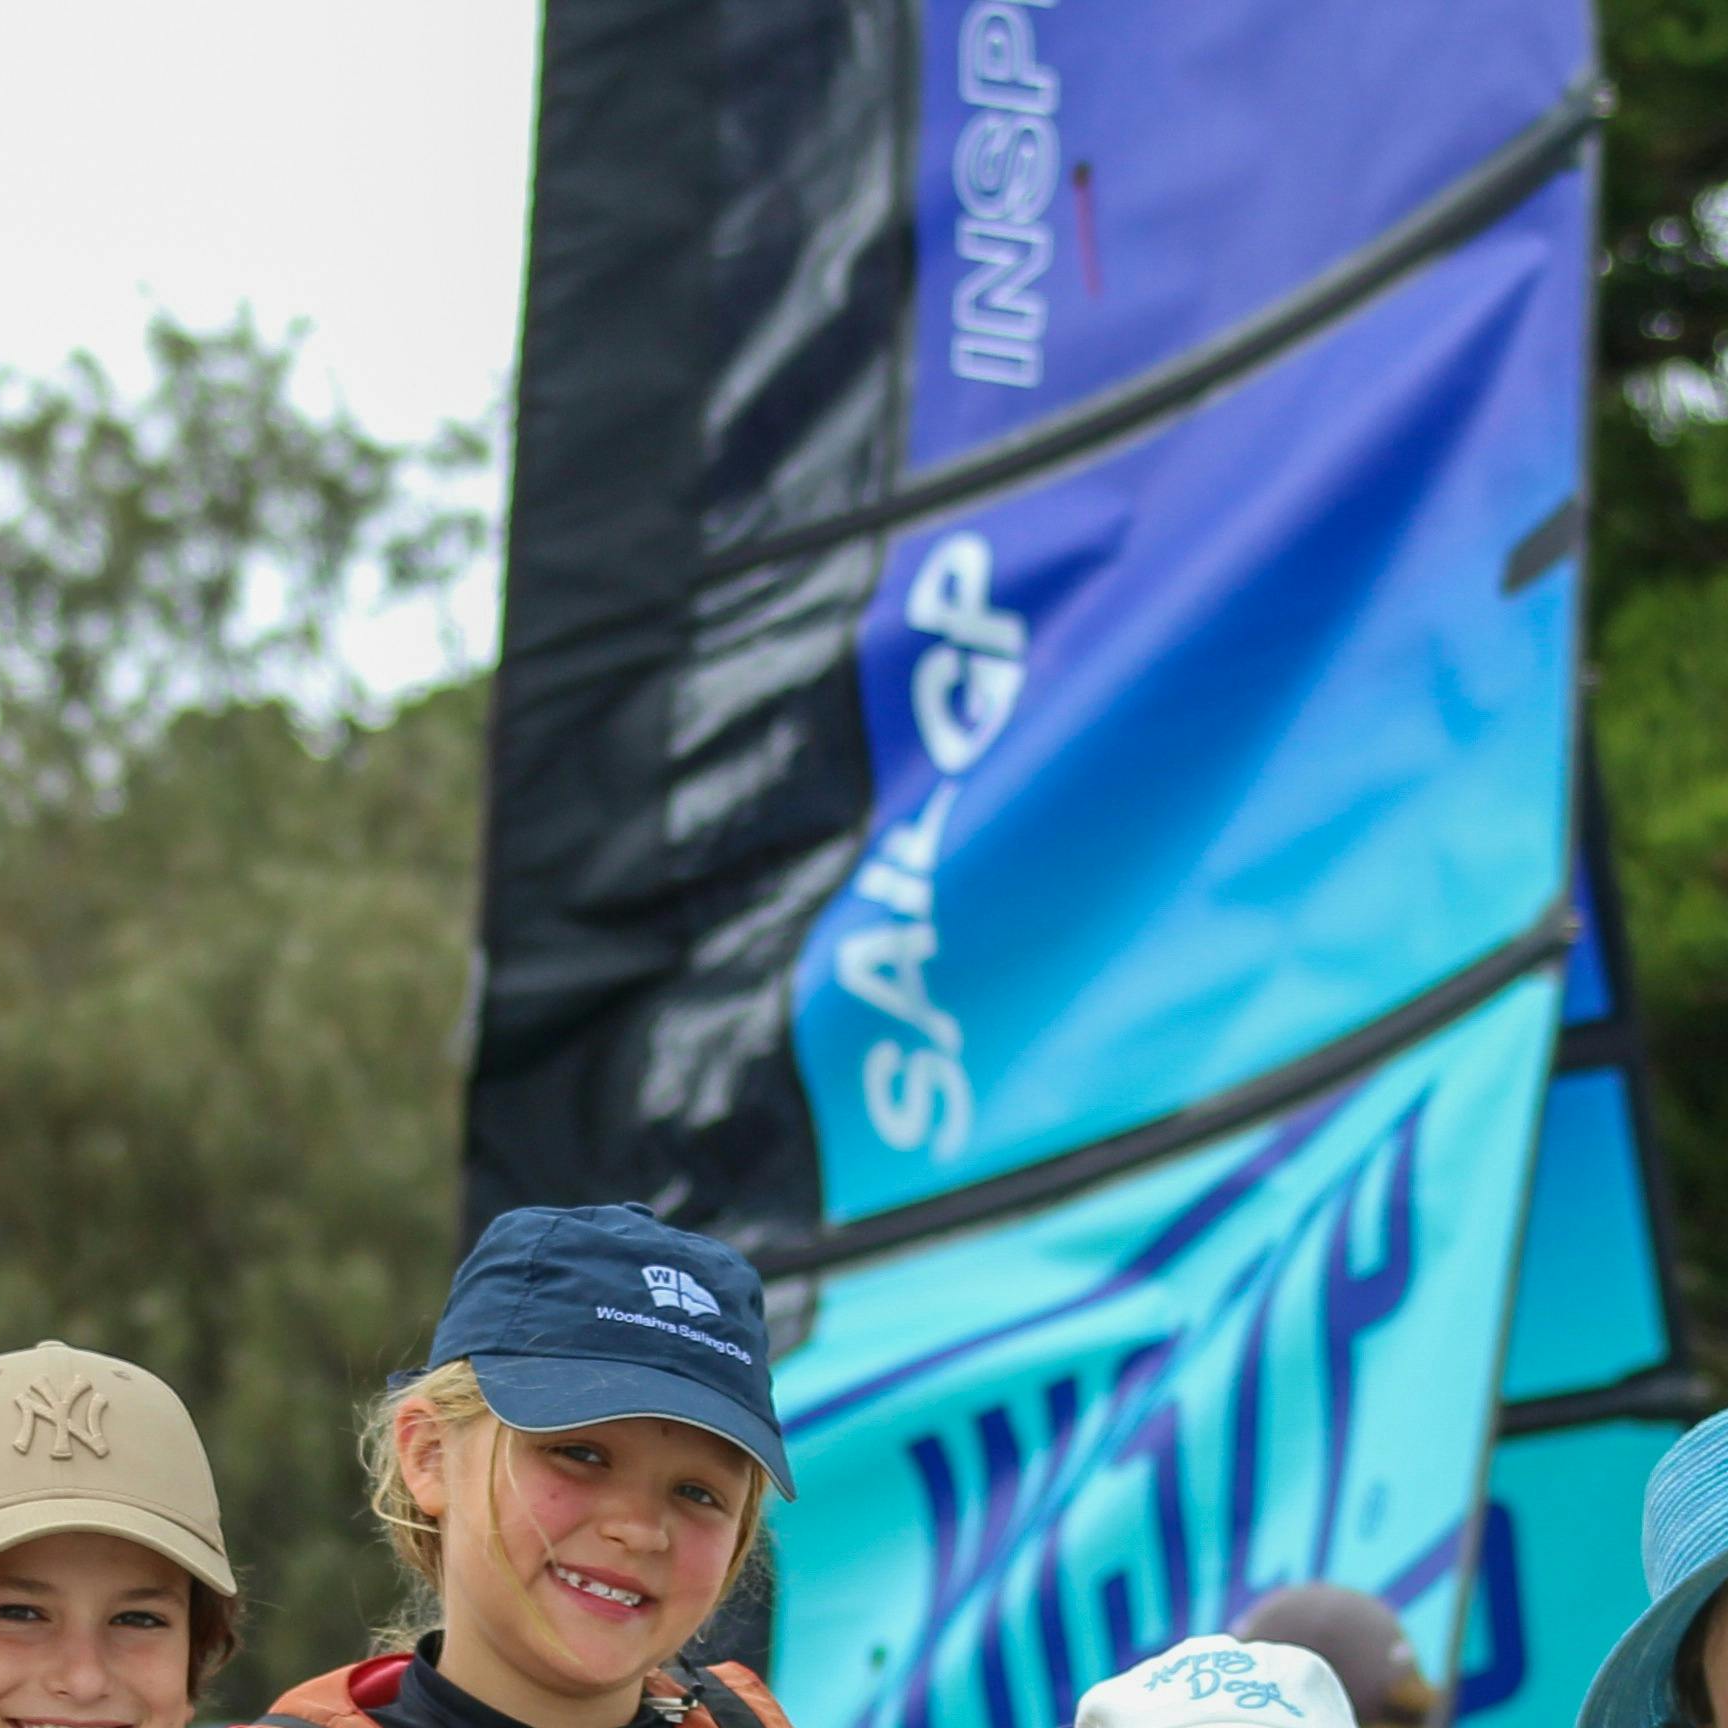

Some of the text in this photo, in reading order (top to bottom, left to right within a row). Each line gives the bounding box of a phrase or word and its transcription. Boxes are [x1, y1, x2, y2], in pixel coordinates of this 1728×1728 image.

[952, 0, 1060, 388] INSP
[678, 1323, 725, 1354] Sailing
[726, 1341, 752, 1366] Club
